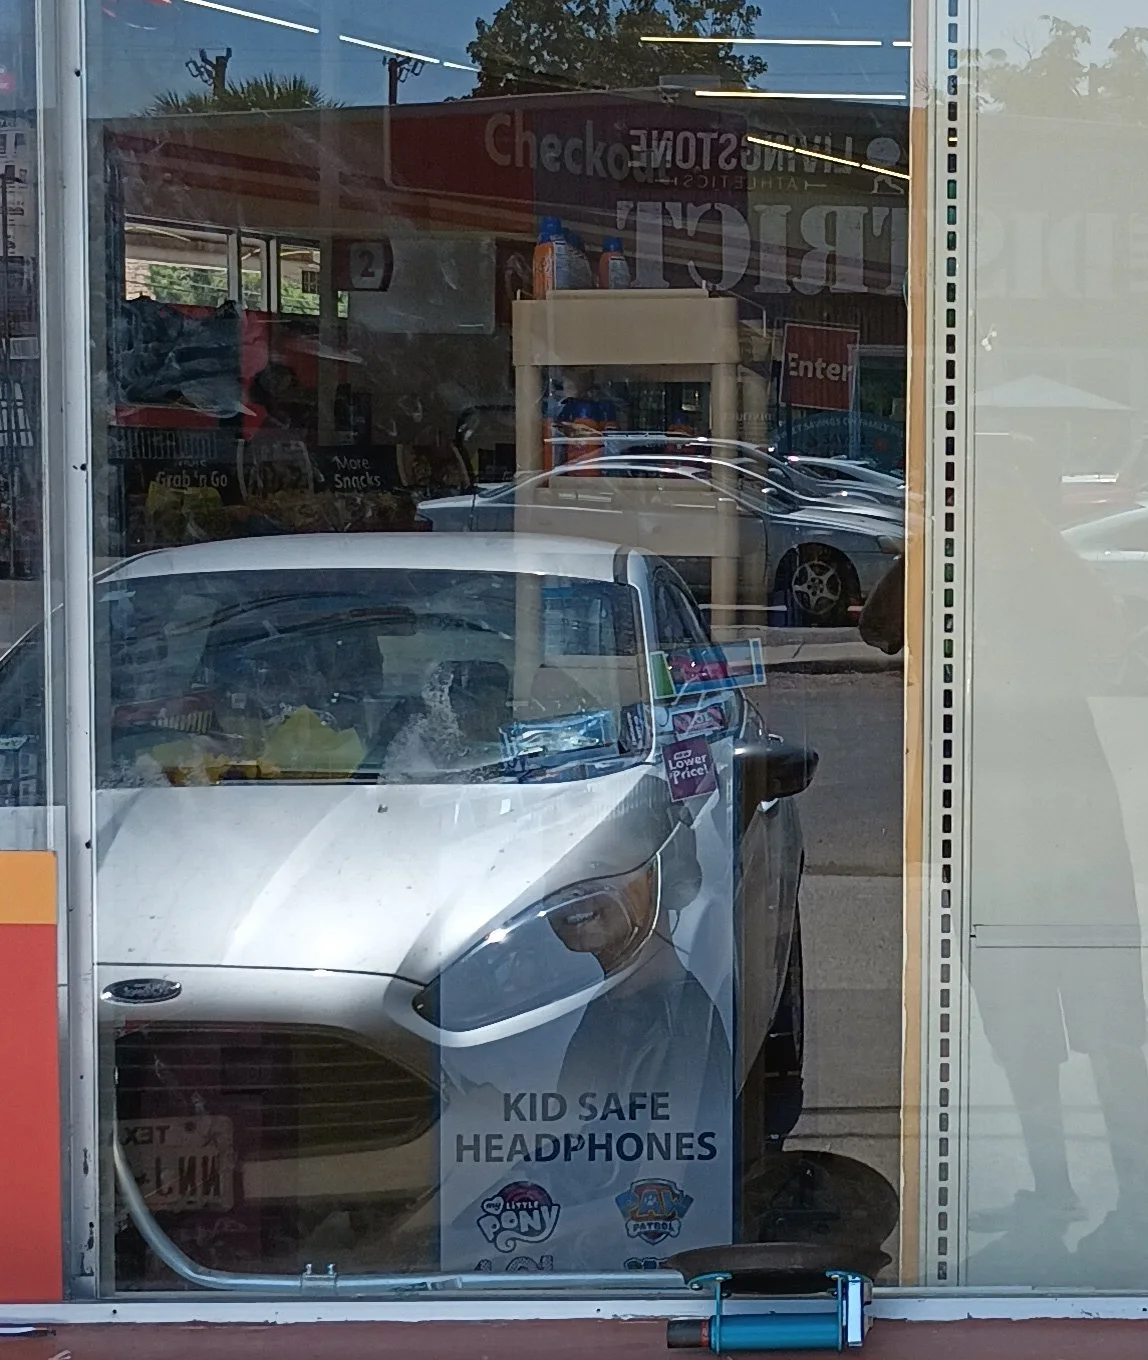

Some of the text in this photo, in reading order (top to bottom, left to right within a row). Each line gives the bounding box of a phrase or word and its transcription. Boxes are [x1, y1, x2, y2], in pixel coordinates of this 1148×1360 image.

[358, 250, 377, 280] 2
[787, 351, 853, 382] Enter
[332, 455, 371, 470] More
[156, 470, 191, 489] Grab
[211, 470, 228, 488] Go
[334, 471, 382, 491] Snacks
[668, 754, 708, 771] Lower
[670, 763, 709, 785] Price!
[503, 1091, 671, 1122] KID SAFE
[455, 1131, 718, 1163] HEADPHONES
[615, 1188, 695, 1221] PAW
[477, 1204, 561, 1245] PONY
[632, 1221, 674, 1232] PATROL
